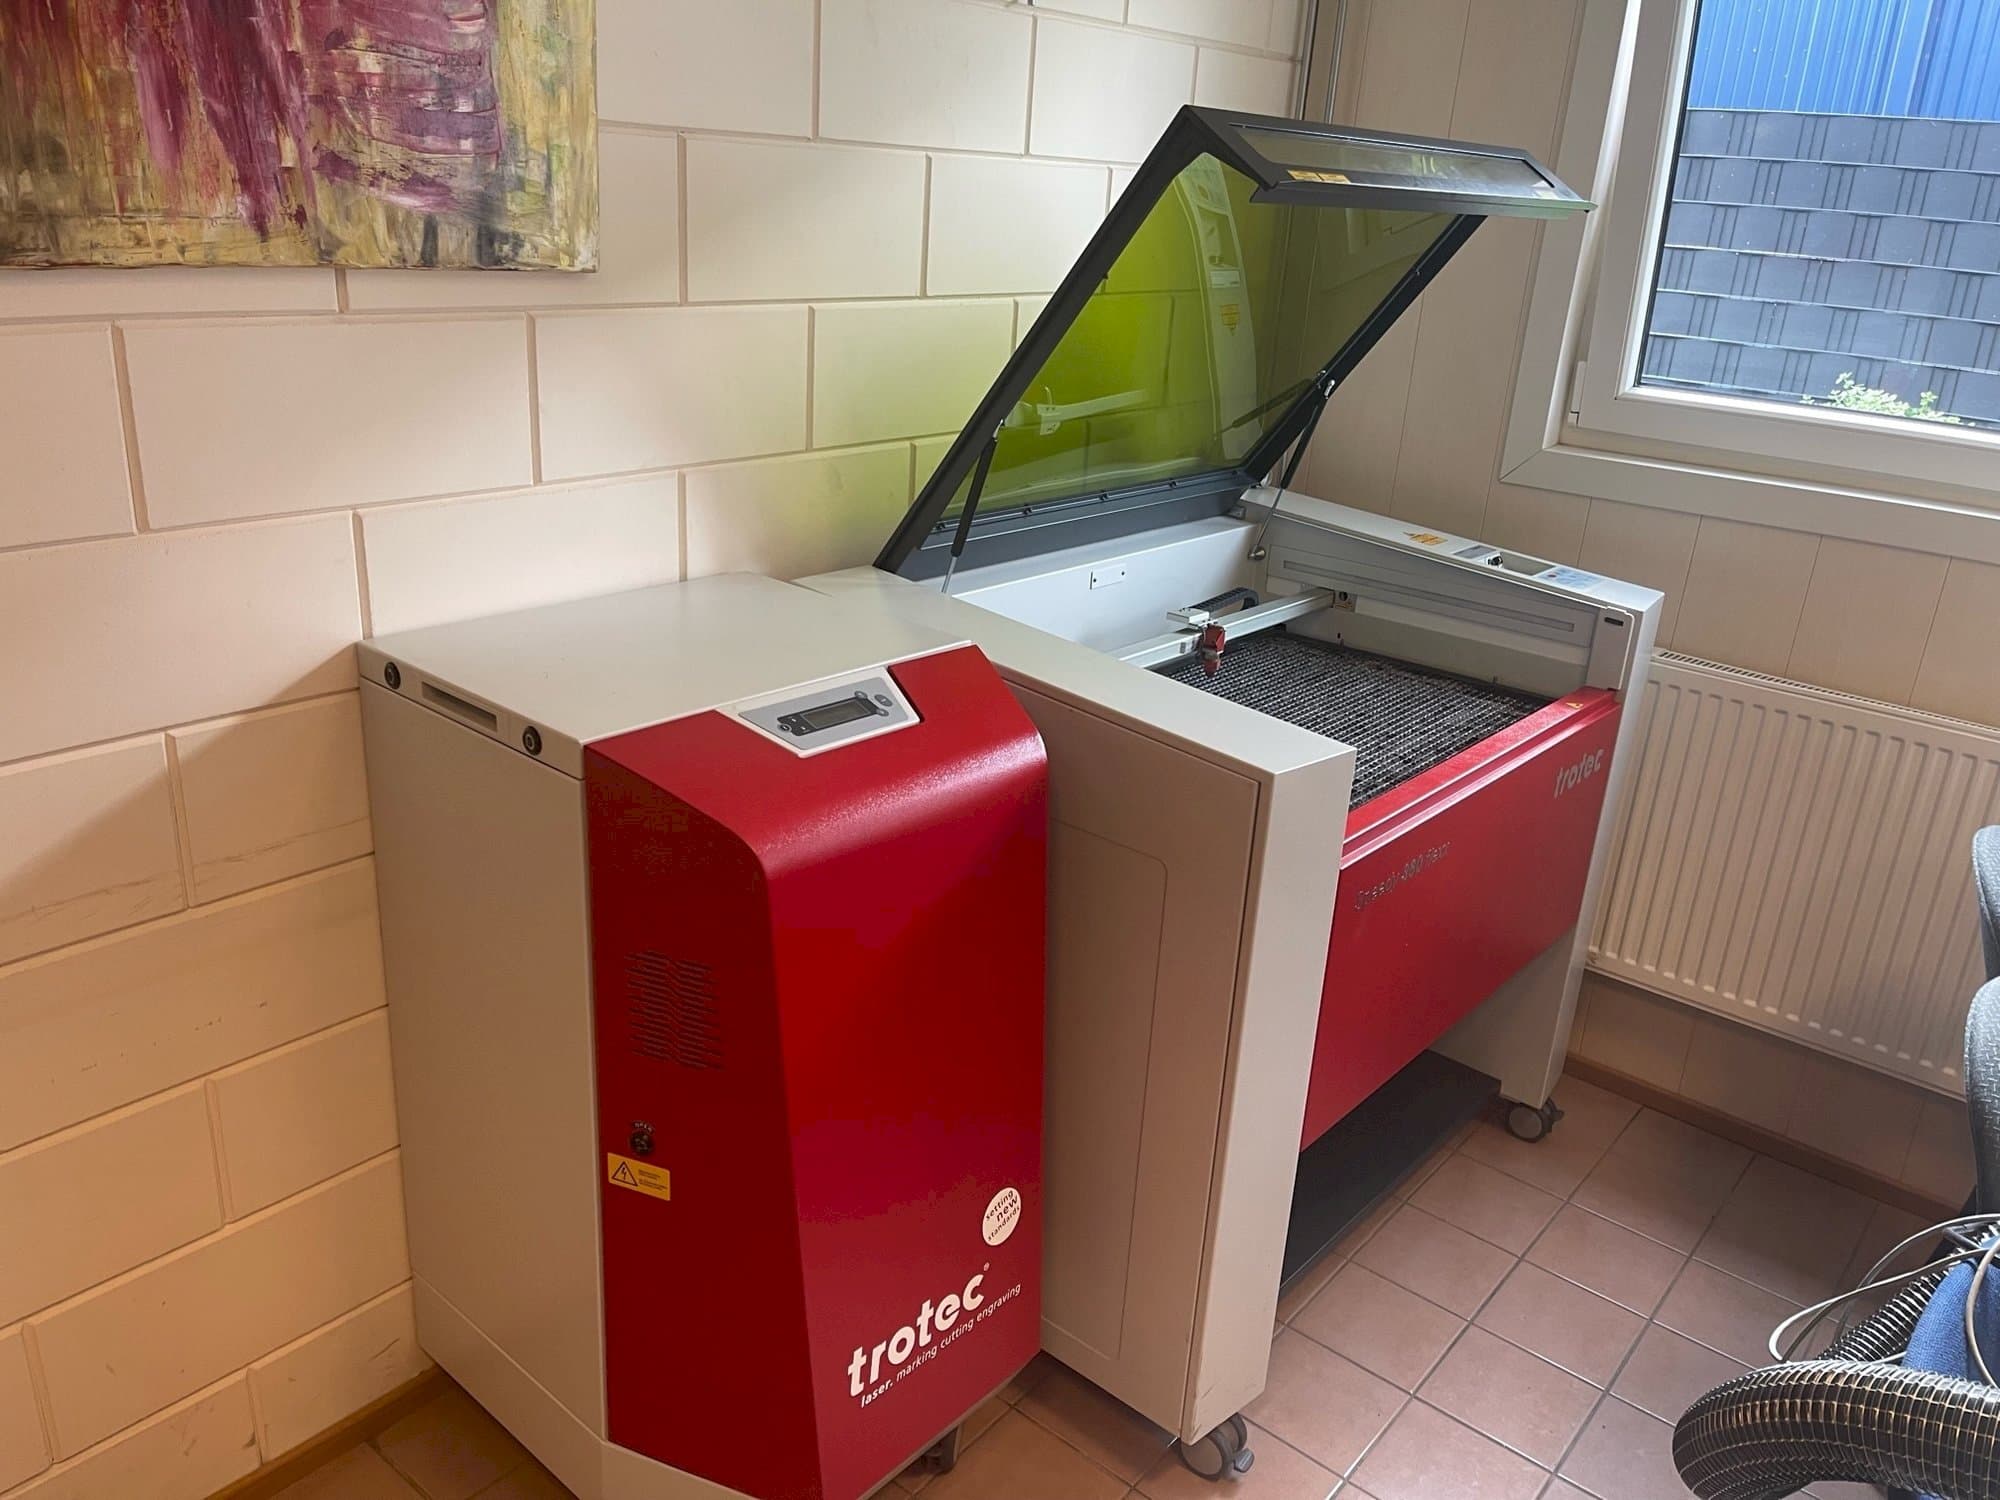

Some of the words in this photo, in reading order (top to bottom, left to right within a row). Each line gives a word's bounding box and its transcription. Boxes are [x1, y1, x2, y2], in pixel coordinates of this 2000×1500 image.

[1554, 749, 1604, 799] trotec
[986, 1190, 1013, 1220] setting
[988, 1205, 1019, 1241] standards
[997, 1195, 1017, 1222] new
[848, 1274, 984, 1397] trotec
[896, 1345, 937, 1382] marking
[940, 1319, 974, 1349] cutting
[976, 1284, 1021, 1322] engraving
